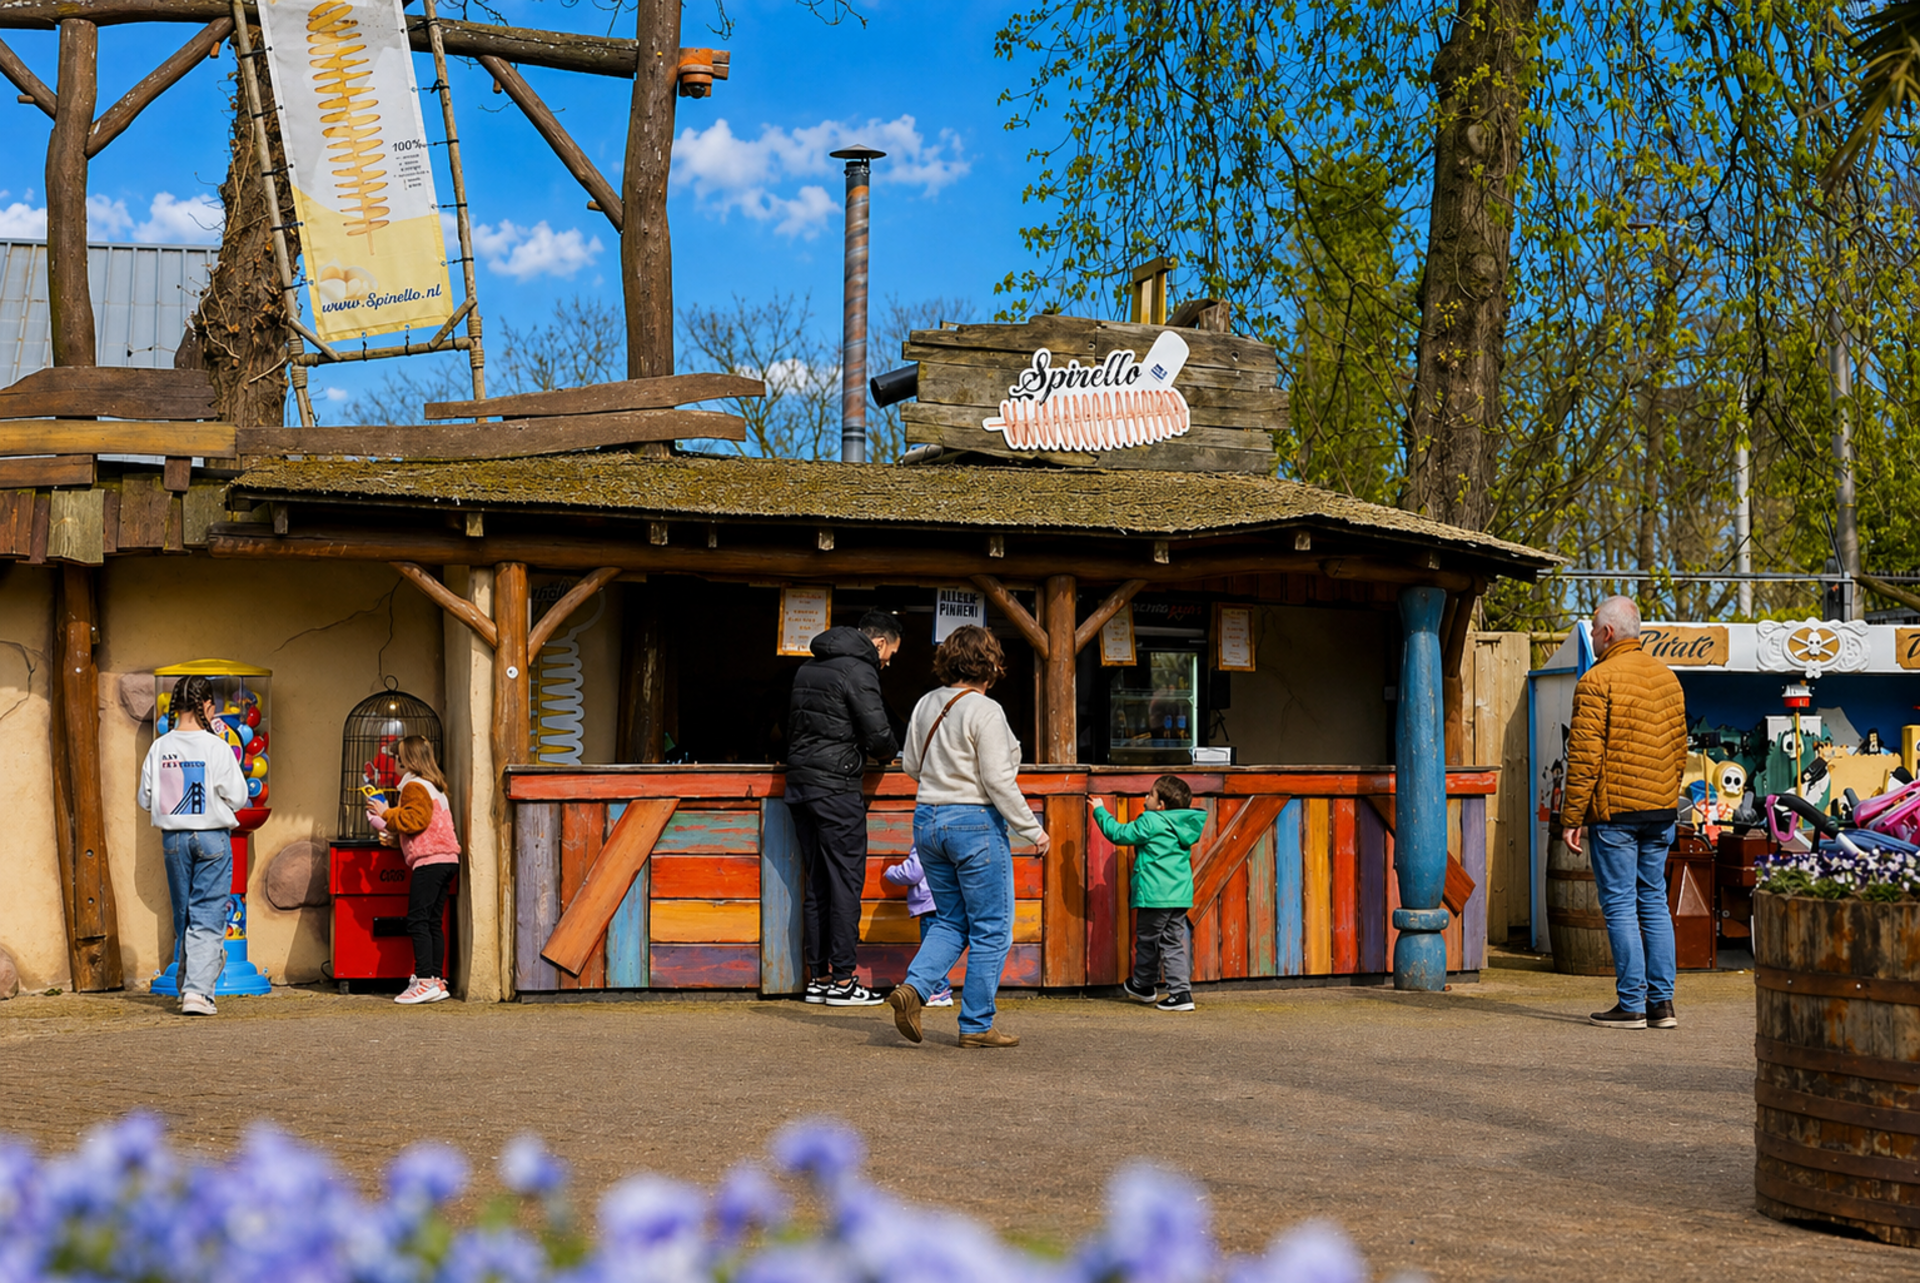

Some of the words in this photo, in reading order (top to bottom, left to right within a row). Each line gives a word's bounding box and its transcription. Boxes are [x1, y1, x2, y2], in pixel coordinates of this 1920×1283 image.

[392, 139, 421, 151] 100%
[322, 283, 442, 313] www.Spinello.nl
[1012, 352, 1142, 406] Spinello
[1640, 630, 1714, 659] Pirate
